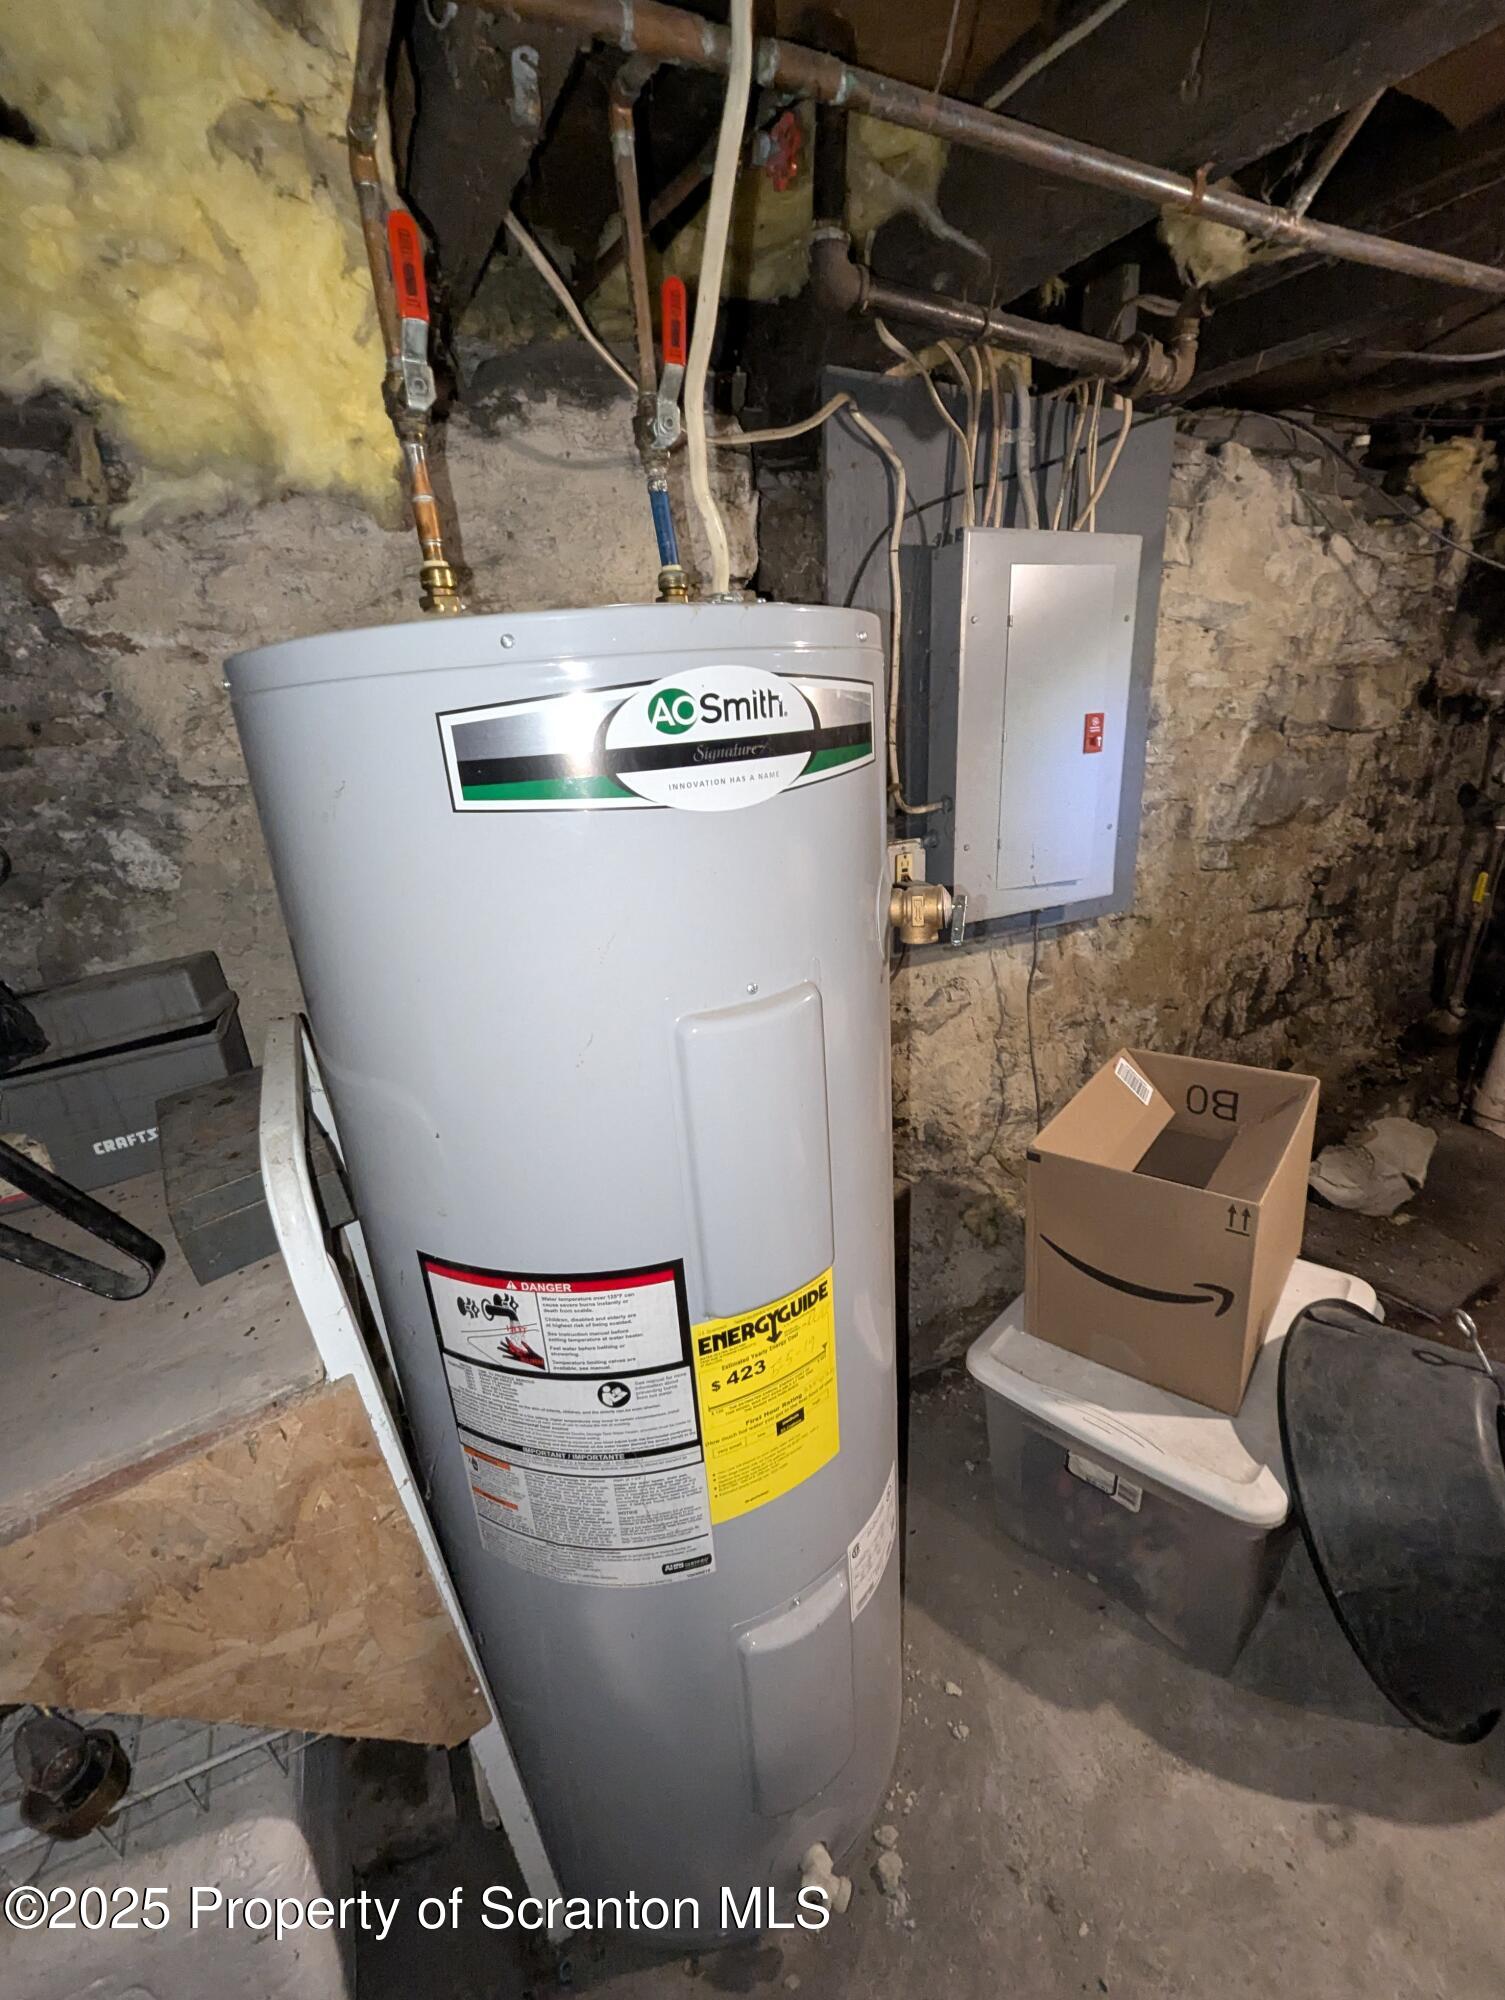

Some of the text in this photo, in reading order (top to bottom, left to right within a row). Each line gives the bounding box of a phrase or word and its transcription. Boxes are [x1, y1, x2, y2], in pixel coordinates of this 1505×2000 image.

[692, 742, 766, 763] Signature
[668, 778, 726, 791] INNOVATION
[730, 775, 746, 784] HAS
[758, 770, 780, 780] NAME
[521, 1282, 571, 1292] DANGER
[698, 1280, 828, 1357] ENERGYGUIDE
[711, 1380, 721, 1392] $
[726, 1359, 766, 1385] 423
[522, 1447, 566, 1459] IMPORTANT
